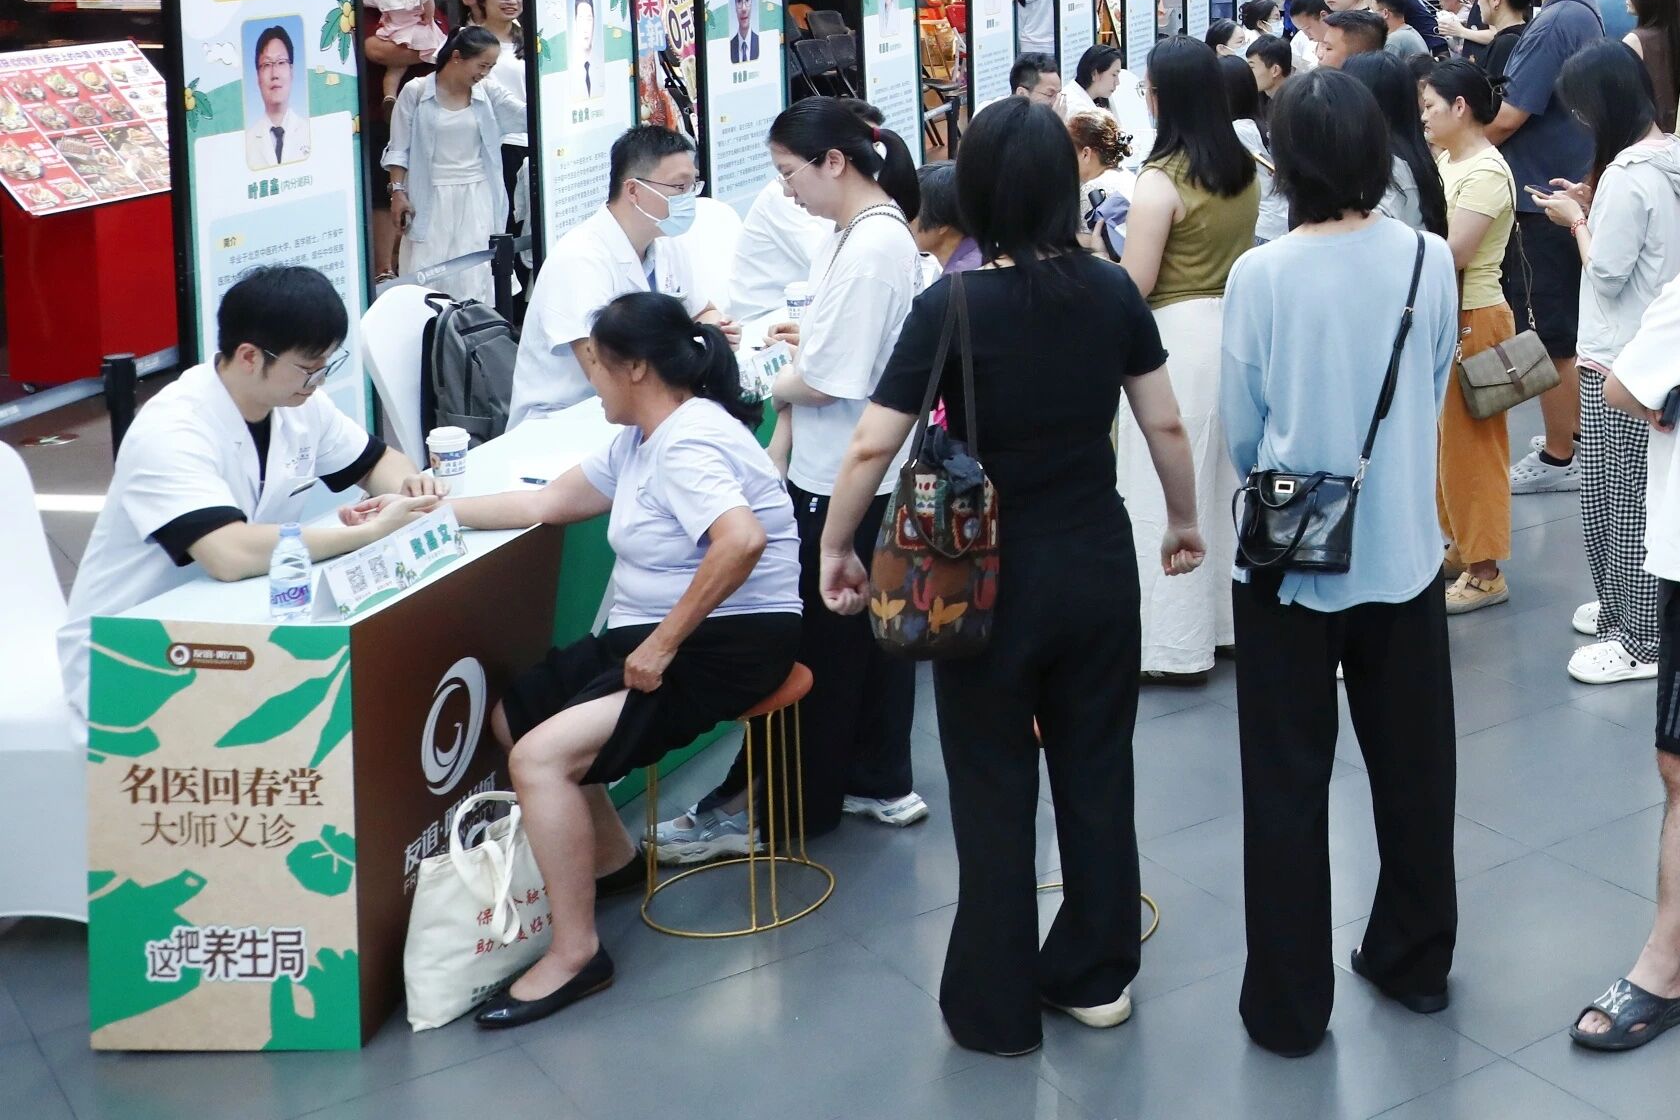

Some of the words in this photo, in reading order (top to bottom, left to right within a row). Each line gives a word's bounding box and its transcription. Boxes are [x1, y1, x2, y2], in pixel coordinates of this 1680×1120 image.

[668, 6, 695, 49] 0元
[121, 765, 324, 809] 名医回春堂
[140, 810, 296, 849] 大师义诊
[149, 927, 305, 982] 这把养生局
